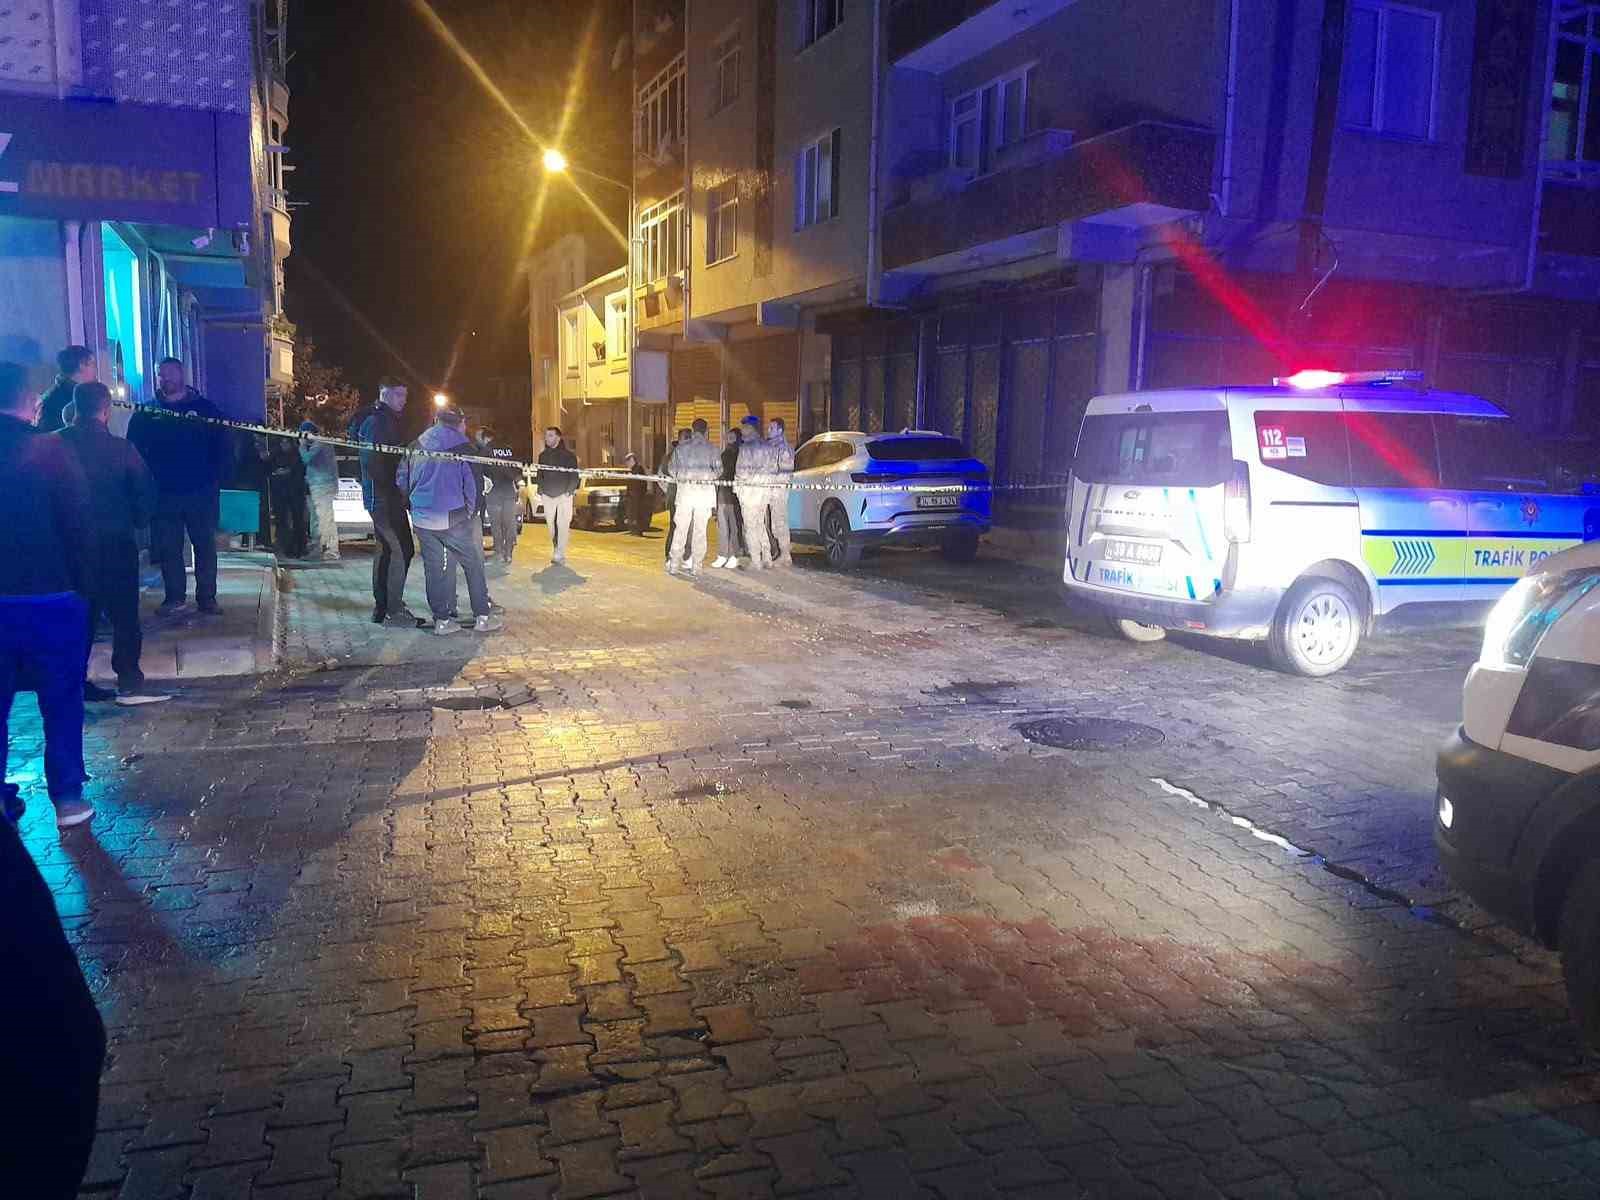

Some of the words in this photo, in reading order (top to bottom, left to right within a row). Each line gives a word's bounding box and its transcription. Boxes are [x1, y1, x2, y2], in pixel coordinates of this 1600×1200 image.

[1262, 427, 1283, 446] 112
[1474, 545, 1525, 567] TRAFİK
[1099, 567, 1134, 585] TRAFİK
